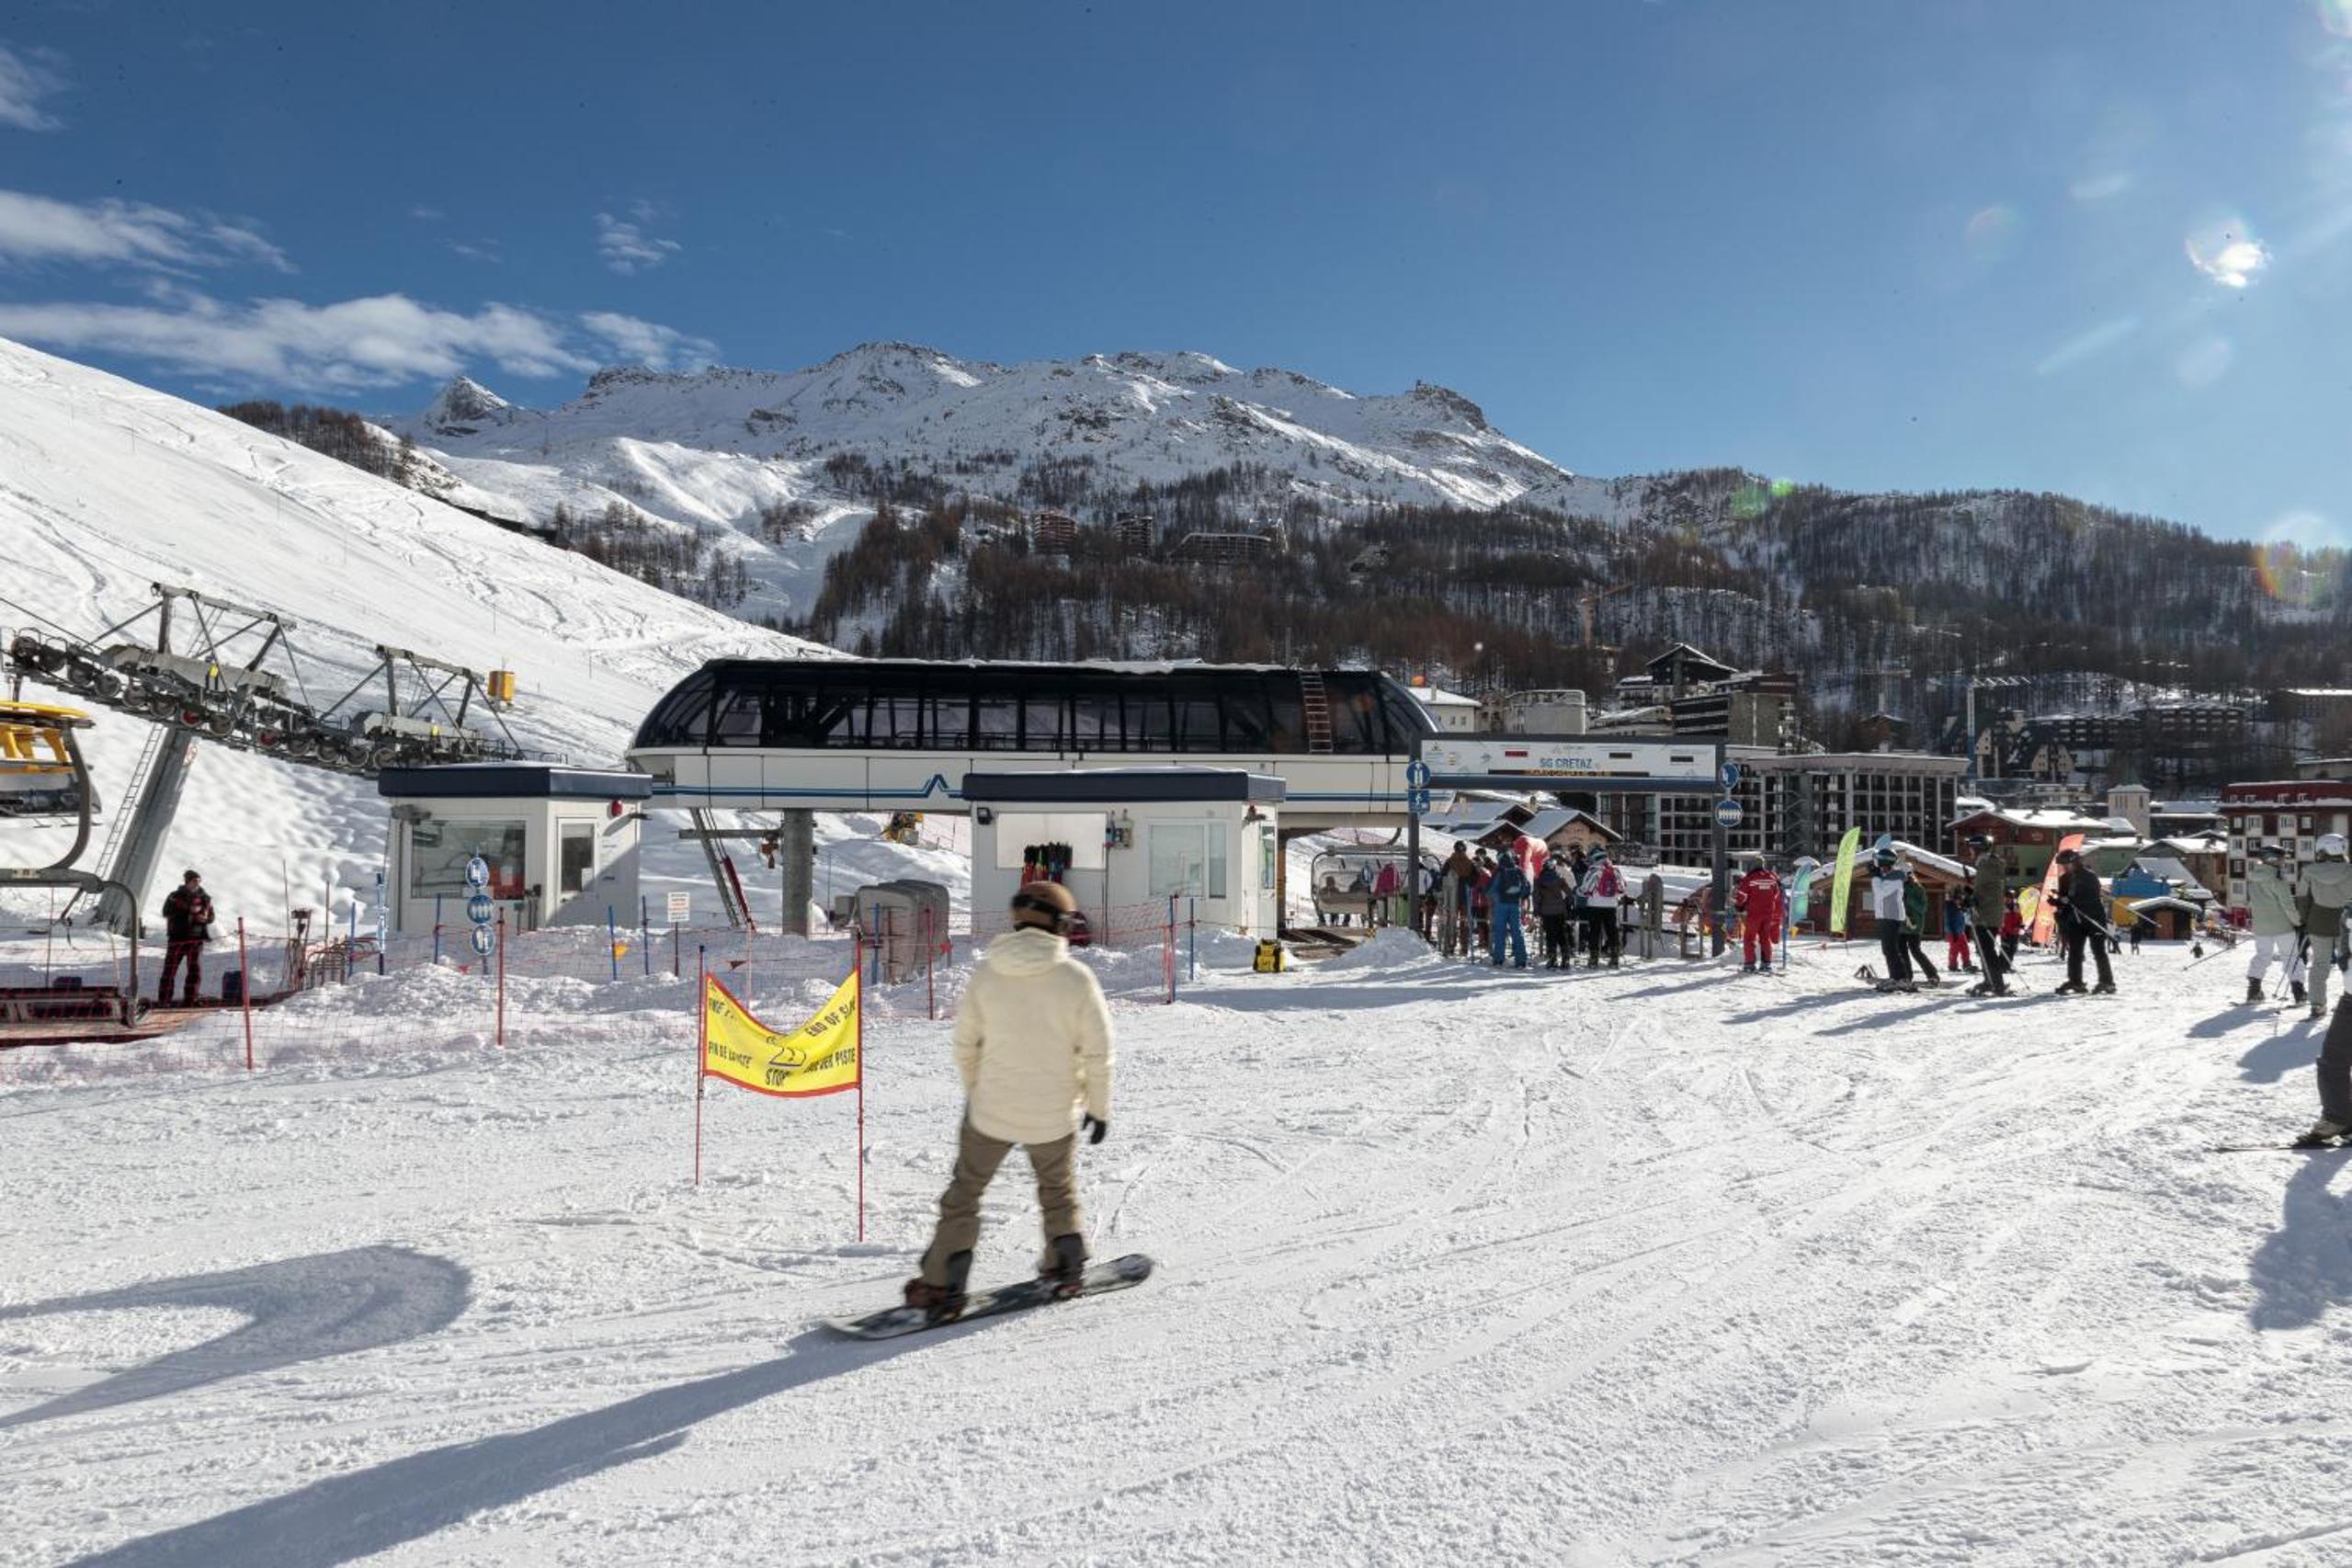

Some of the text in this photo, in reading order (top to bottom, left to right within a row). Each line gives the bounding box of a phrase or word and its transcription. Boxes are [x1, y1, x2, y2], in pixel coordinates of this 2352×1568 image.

[1540, 757, 1593, 769] SG CRETAZ
[804, 1021, 827, 1037] END
[824, 1012, 841, 1026] OF
[835, 1047, 856, 1066] PISTE
